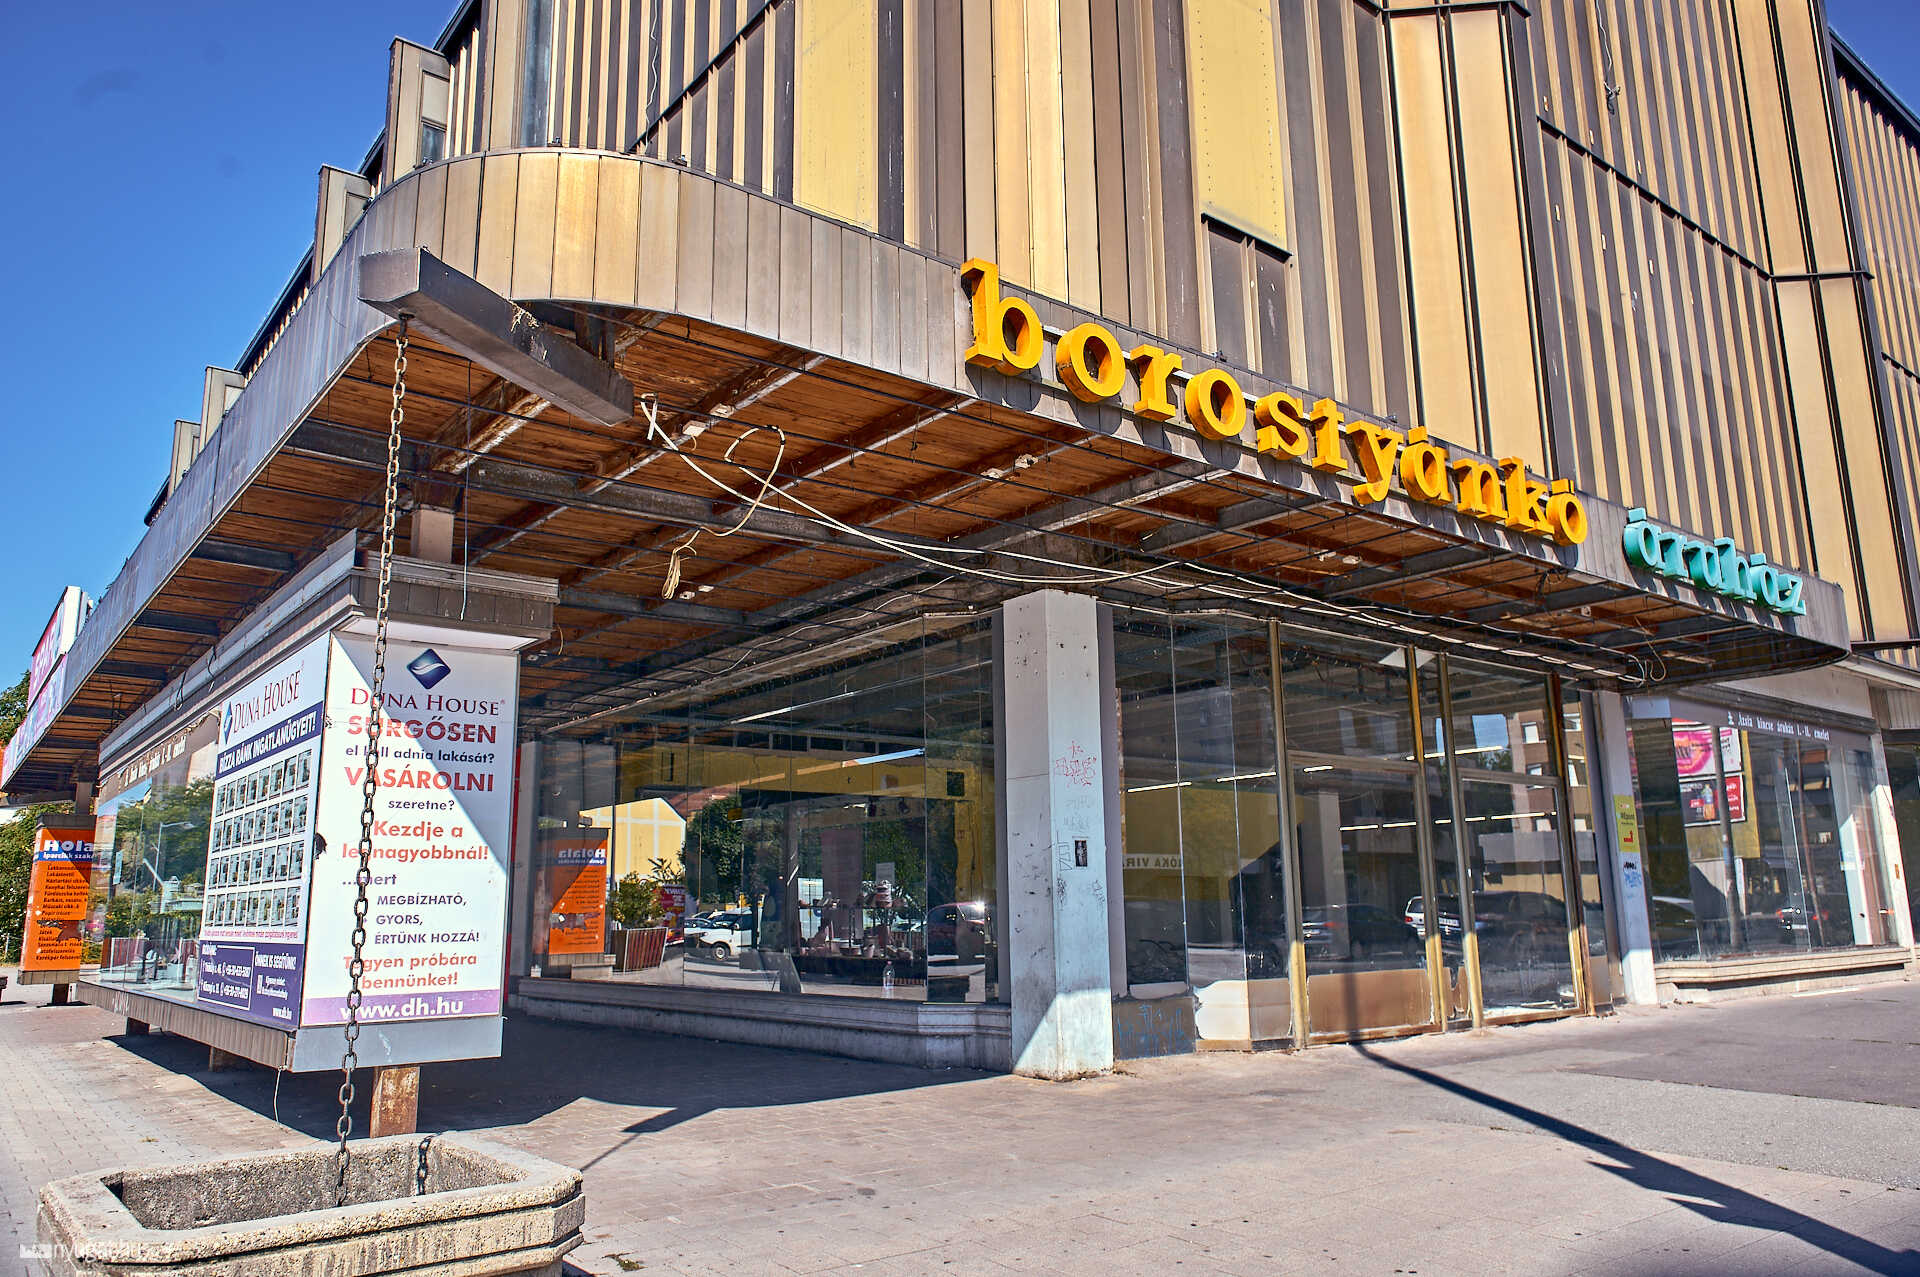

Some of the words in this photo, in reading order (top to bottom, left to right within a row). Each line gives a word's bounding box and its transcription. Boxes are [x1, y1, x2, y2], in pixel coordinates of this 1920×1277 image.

[959, 257, 1588, 547] borostyánkő
[1623, 507, 1807, 616] áruház
[234, 696, 260, 733] DUNA
[263, 670, 300, 718] HOUSE
[427, 694, 500, 716] HOUSE
[345, 745, 358, 756] el
[364, 745, 389, 757] kll
[394, 748, 433, 760] adnia
[438, 750, 495, 763] lakását?
[388, 800, 455, 810] szeretne?
[373, 820, 444, 841] Kezdje
[451, 826, 464, 838] a
[377, 892, 467, 906] MEGBÍZHATÓ,
[376, 914, 423, 926] GYORS,
[374, 931, 427, 945] ÉRTÜNK
[430, 929, 480, 943] HOZZÁ!
[410, 952, 478, 970] próbára
[362, 971, 459, 989] bennünket!
[339, 996, 464, 1020] www.dh.hu
